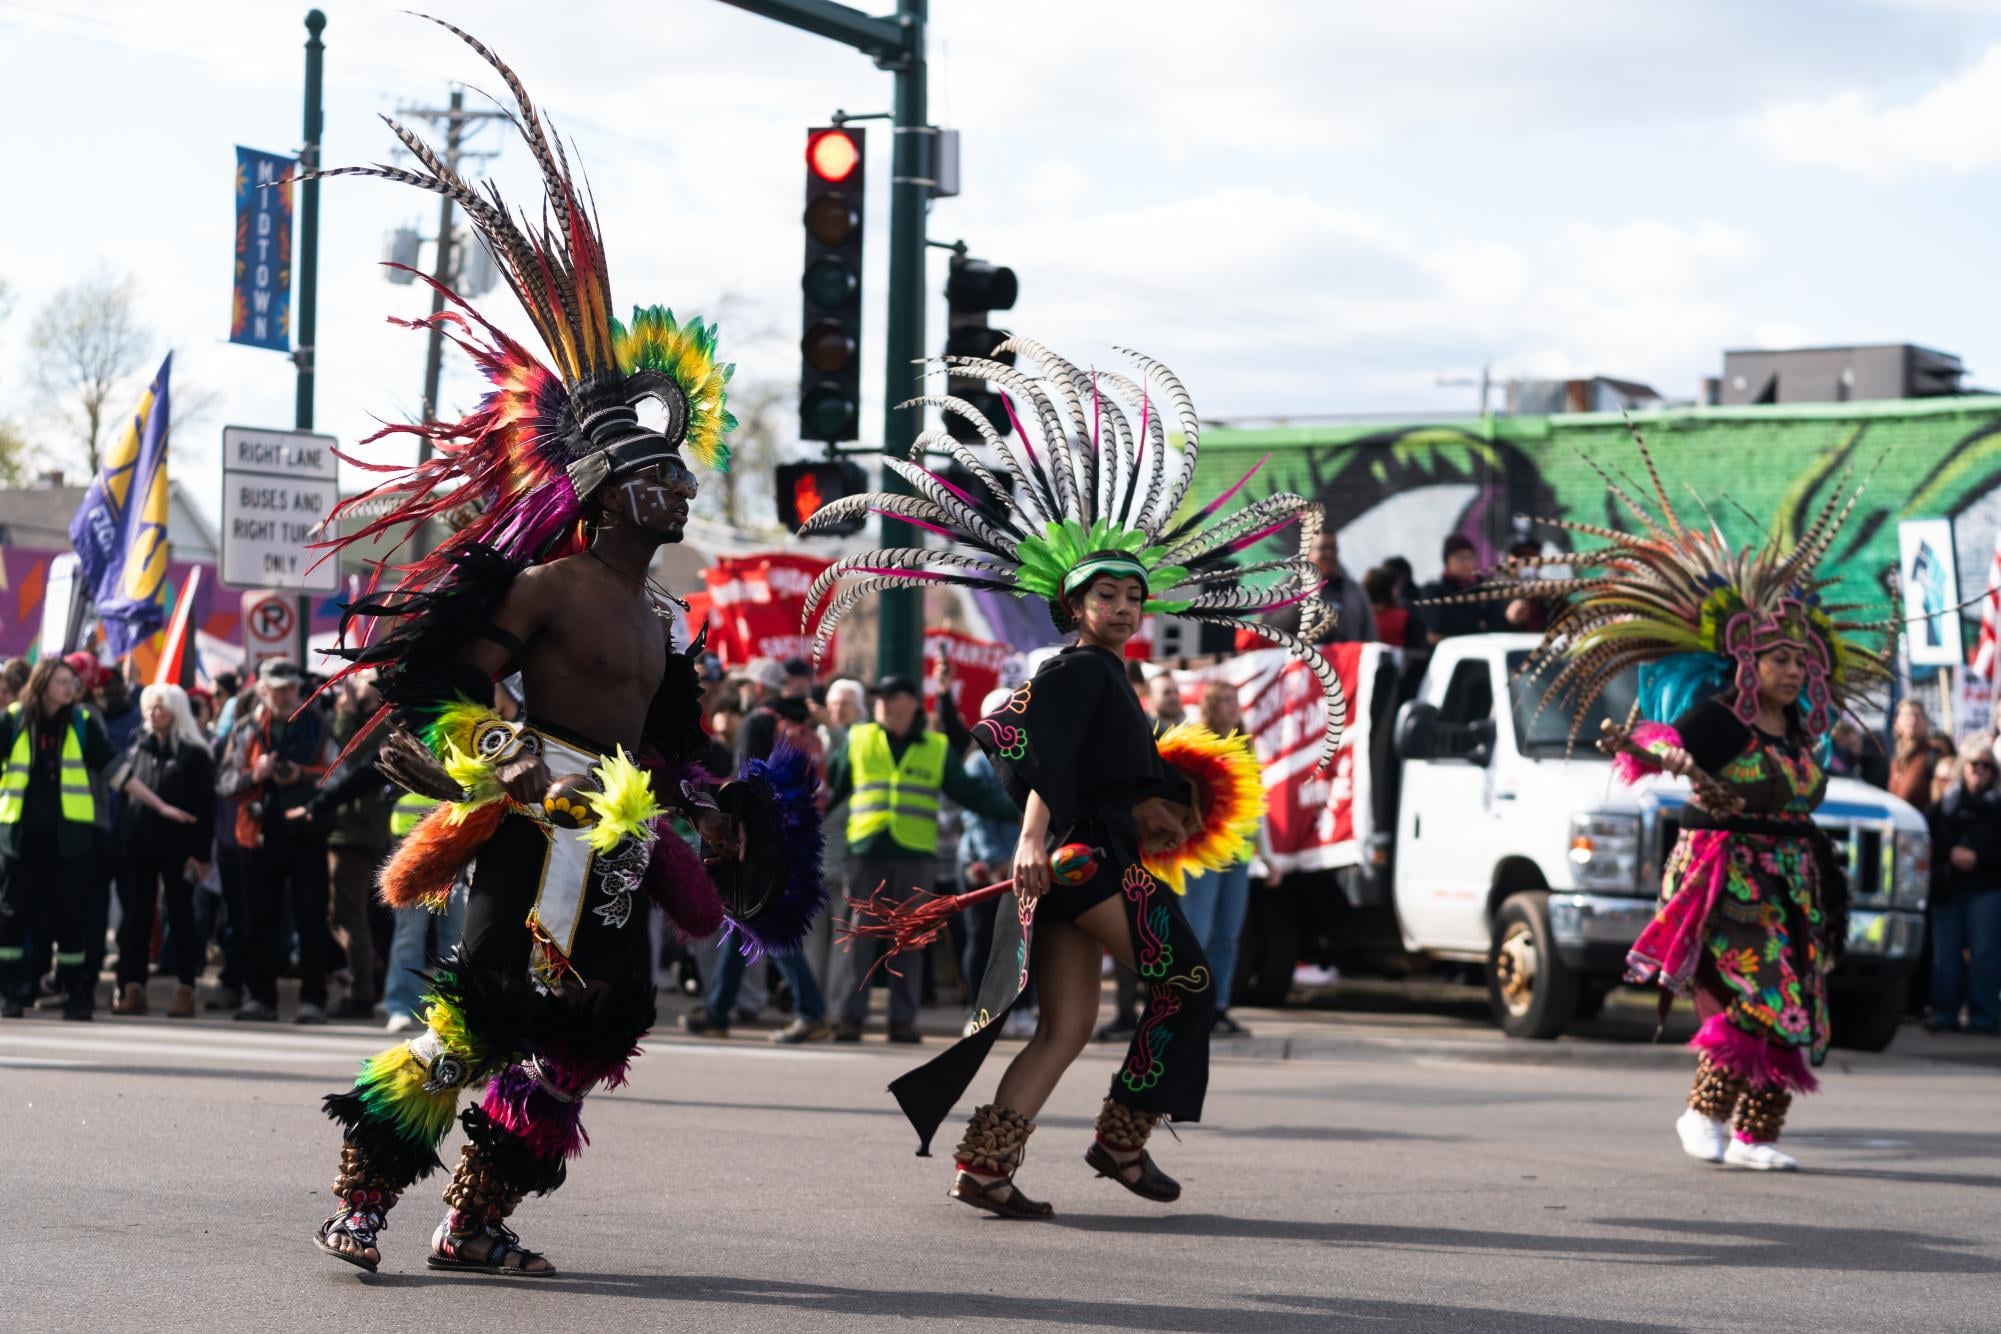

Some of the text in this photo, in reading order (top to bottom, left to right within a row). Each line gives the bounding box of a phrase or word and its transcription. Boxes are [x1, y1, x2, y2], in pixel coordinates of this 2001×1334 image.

[253, 159, 274, 341] MIDTOWN
[238, 441, 323, 470] RIGHT LANE
[240, 486, 323, 514] BUSES AND
[232, 518, 276, 541] RIGHT
[263, 552, 297, 575] ONLY
